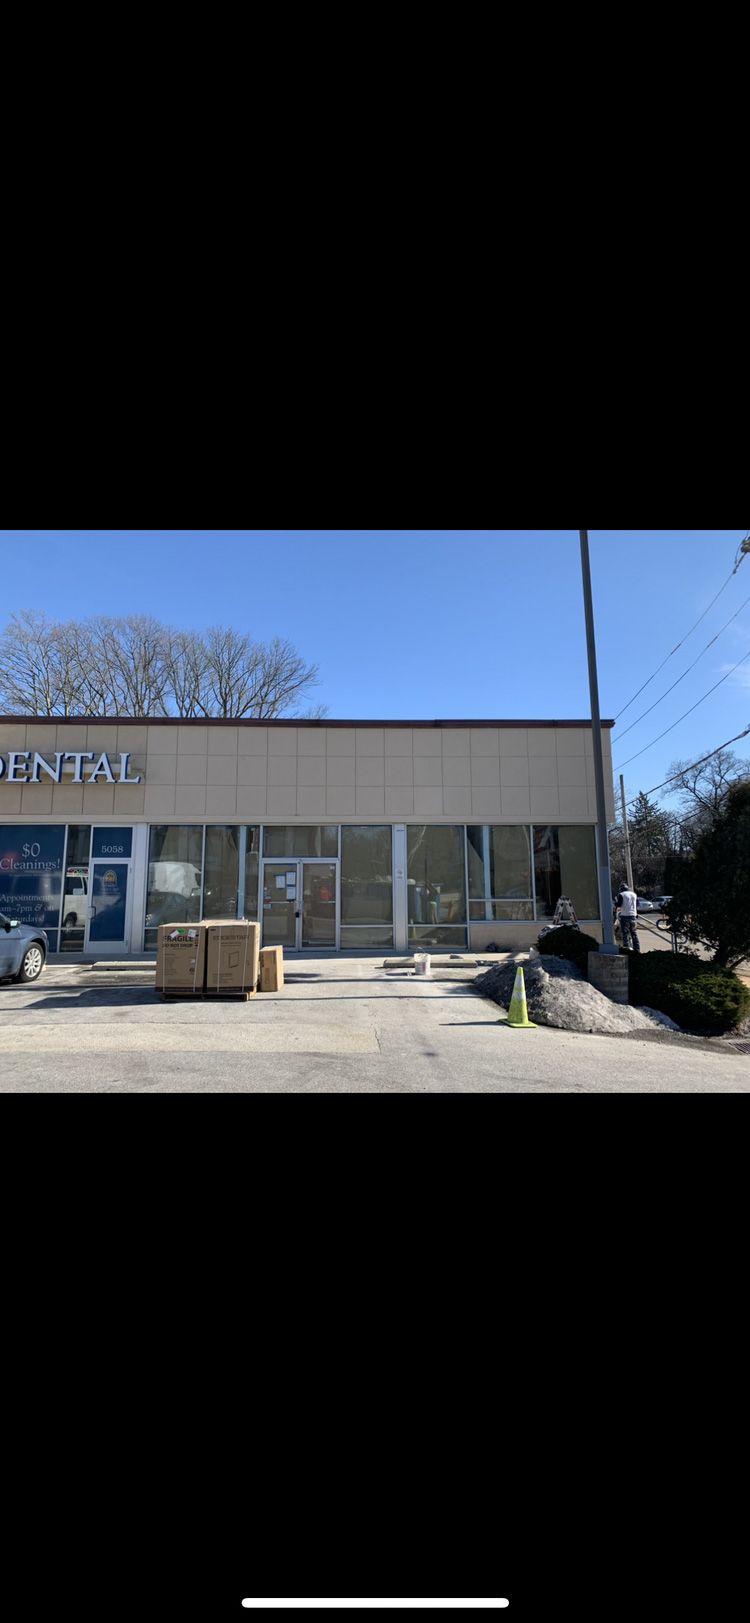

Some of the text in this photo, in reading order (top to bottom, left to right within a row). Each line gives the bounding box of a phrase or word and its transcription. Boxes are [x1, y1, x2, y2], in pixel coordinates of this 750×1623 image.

[0, 751, 141, 784] ENTAL
[22, 842, 41, 859] $0
[101, 845, 124, 854] 5058
[0, 858, 60, 871] Cleanings!
